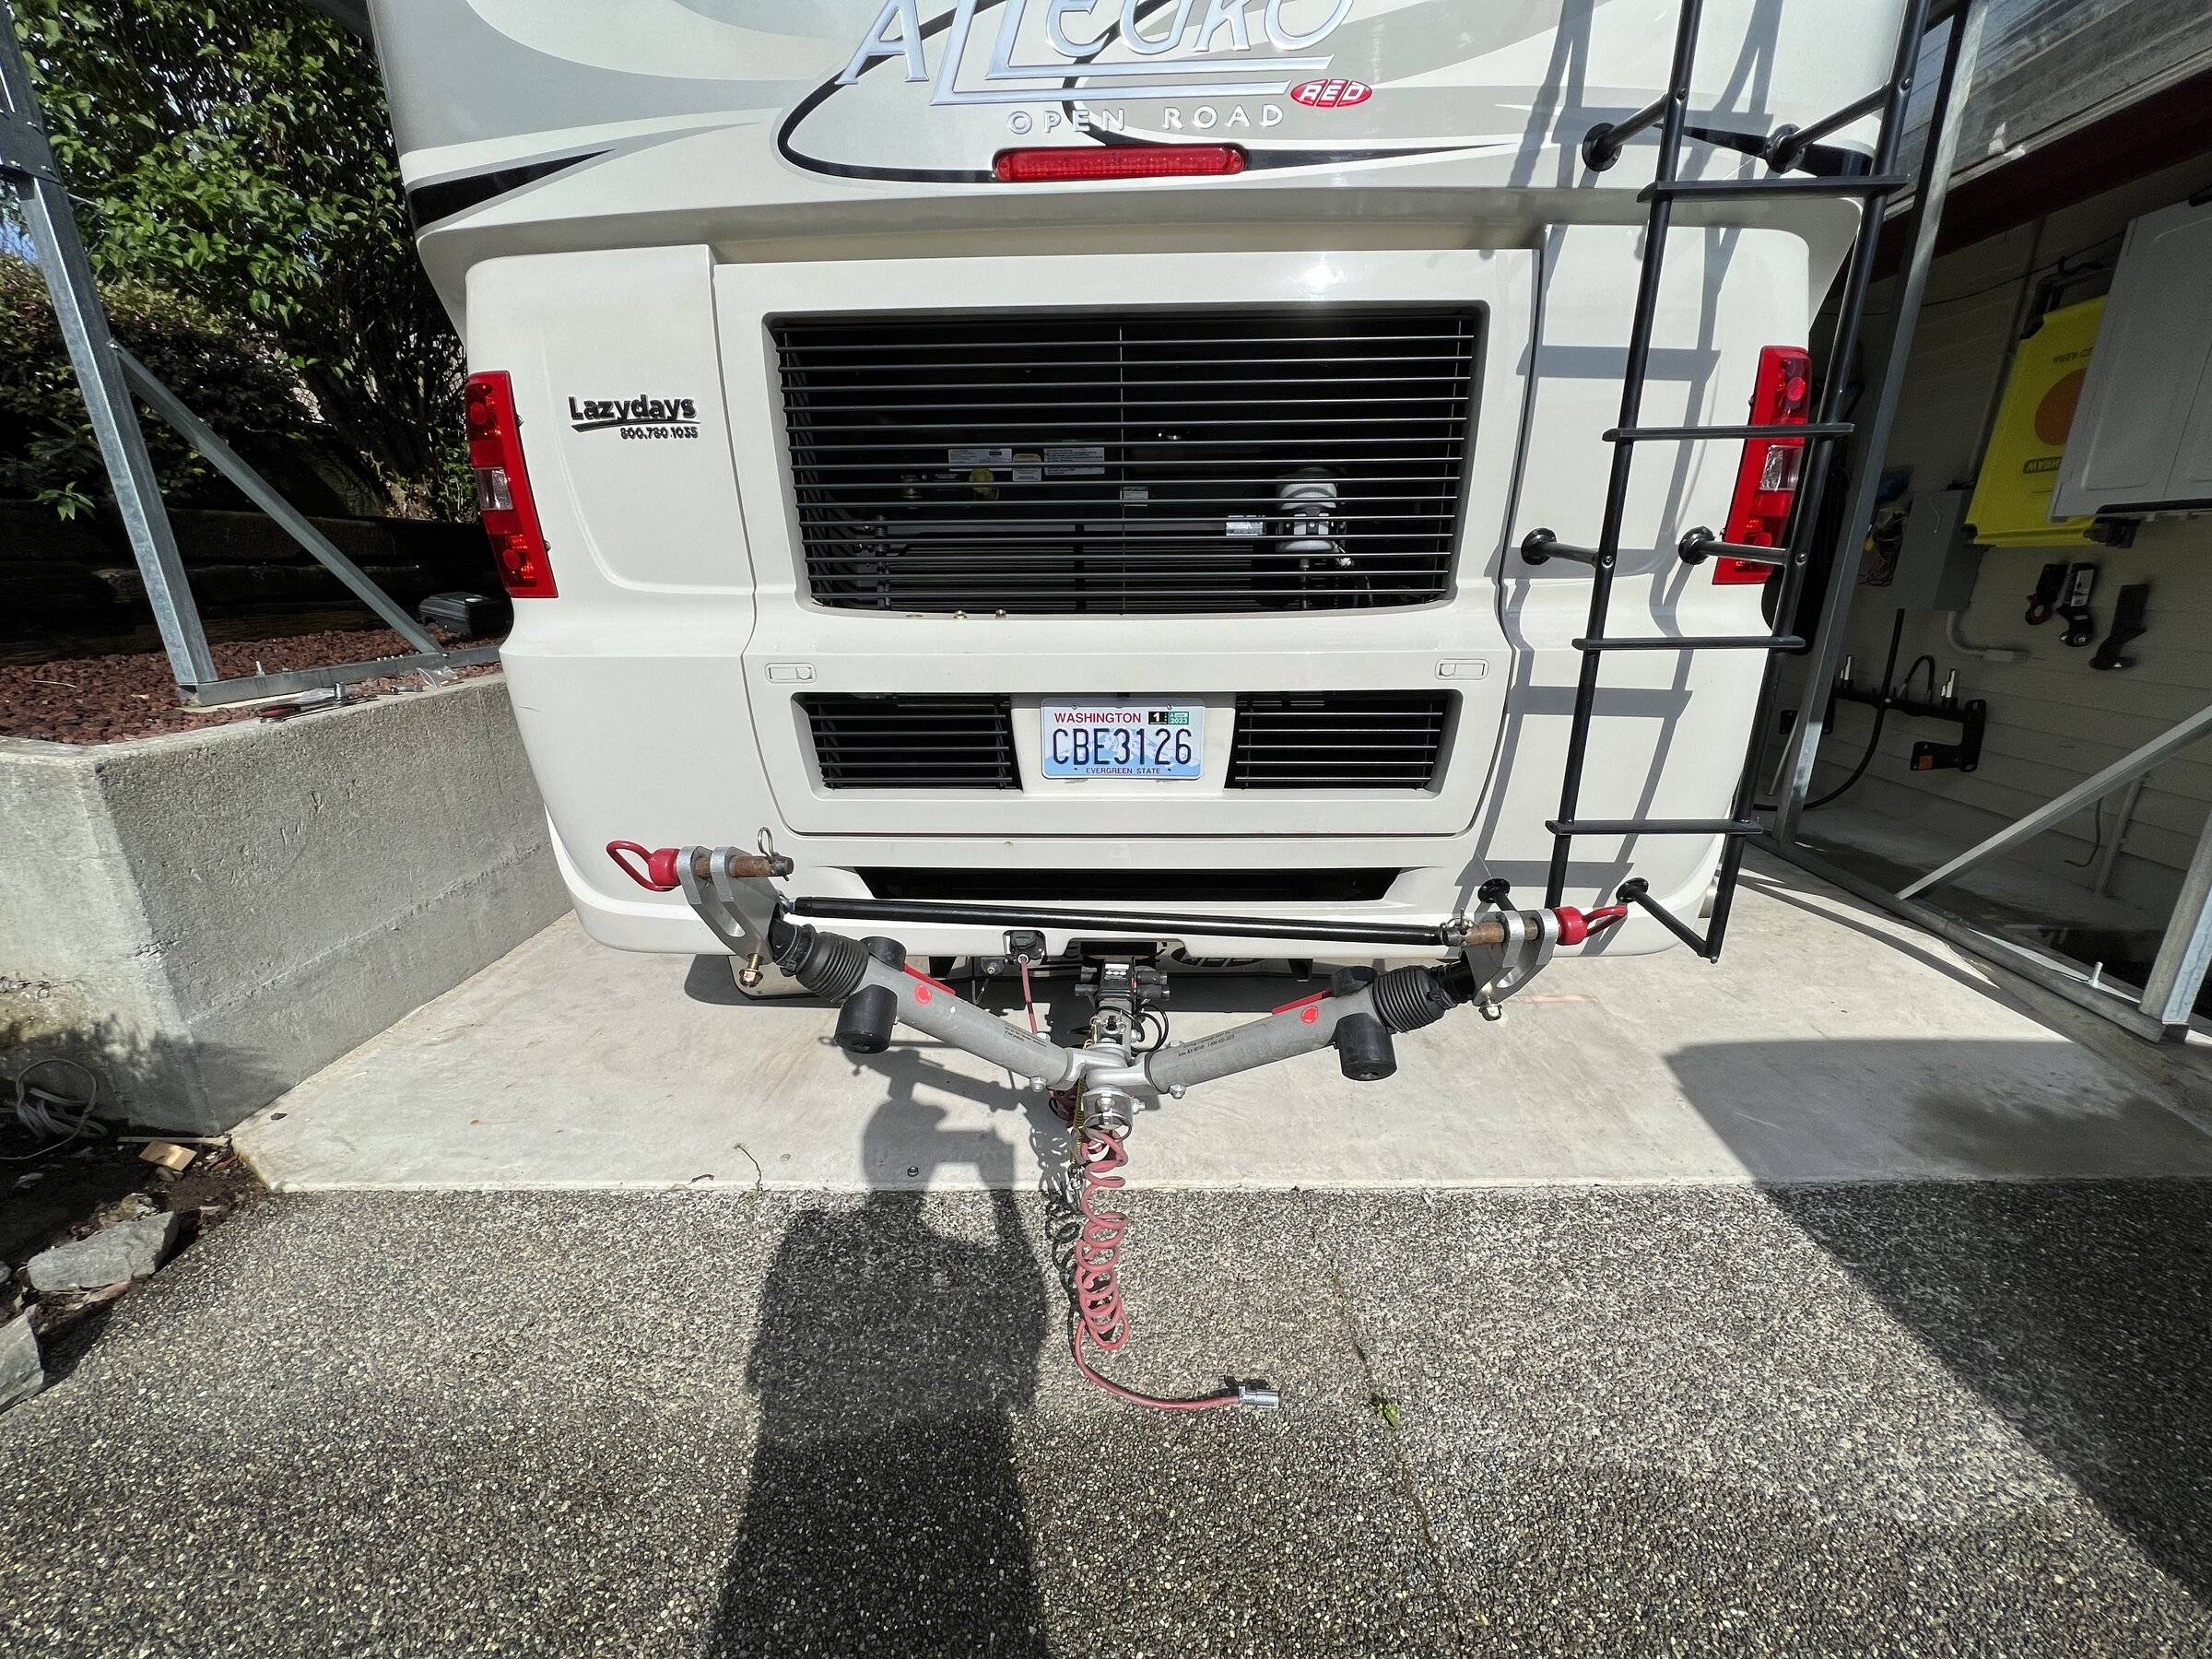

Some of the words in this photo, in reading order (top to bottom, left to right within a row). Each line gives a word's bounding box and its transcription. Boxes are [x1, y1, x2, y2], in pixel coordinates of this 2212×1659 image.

[1297, 83, 1366, 102] RED
[1007, 107, 1126, 135] OPEN
[1163, 103, 1285, 131] ROAD
[568, 394, 698, 421] Lazydays
[1054, 712, 1141, 724] WASHINGTON
[1053, 728, 1192, 765] CBE3126
